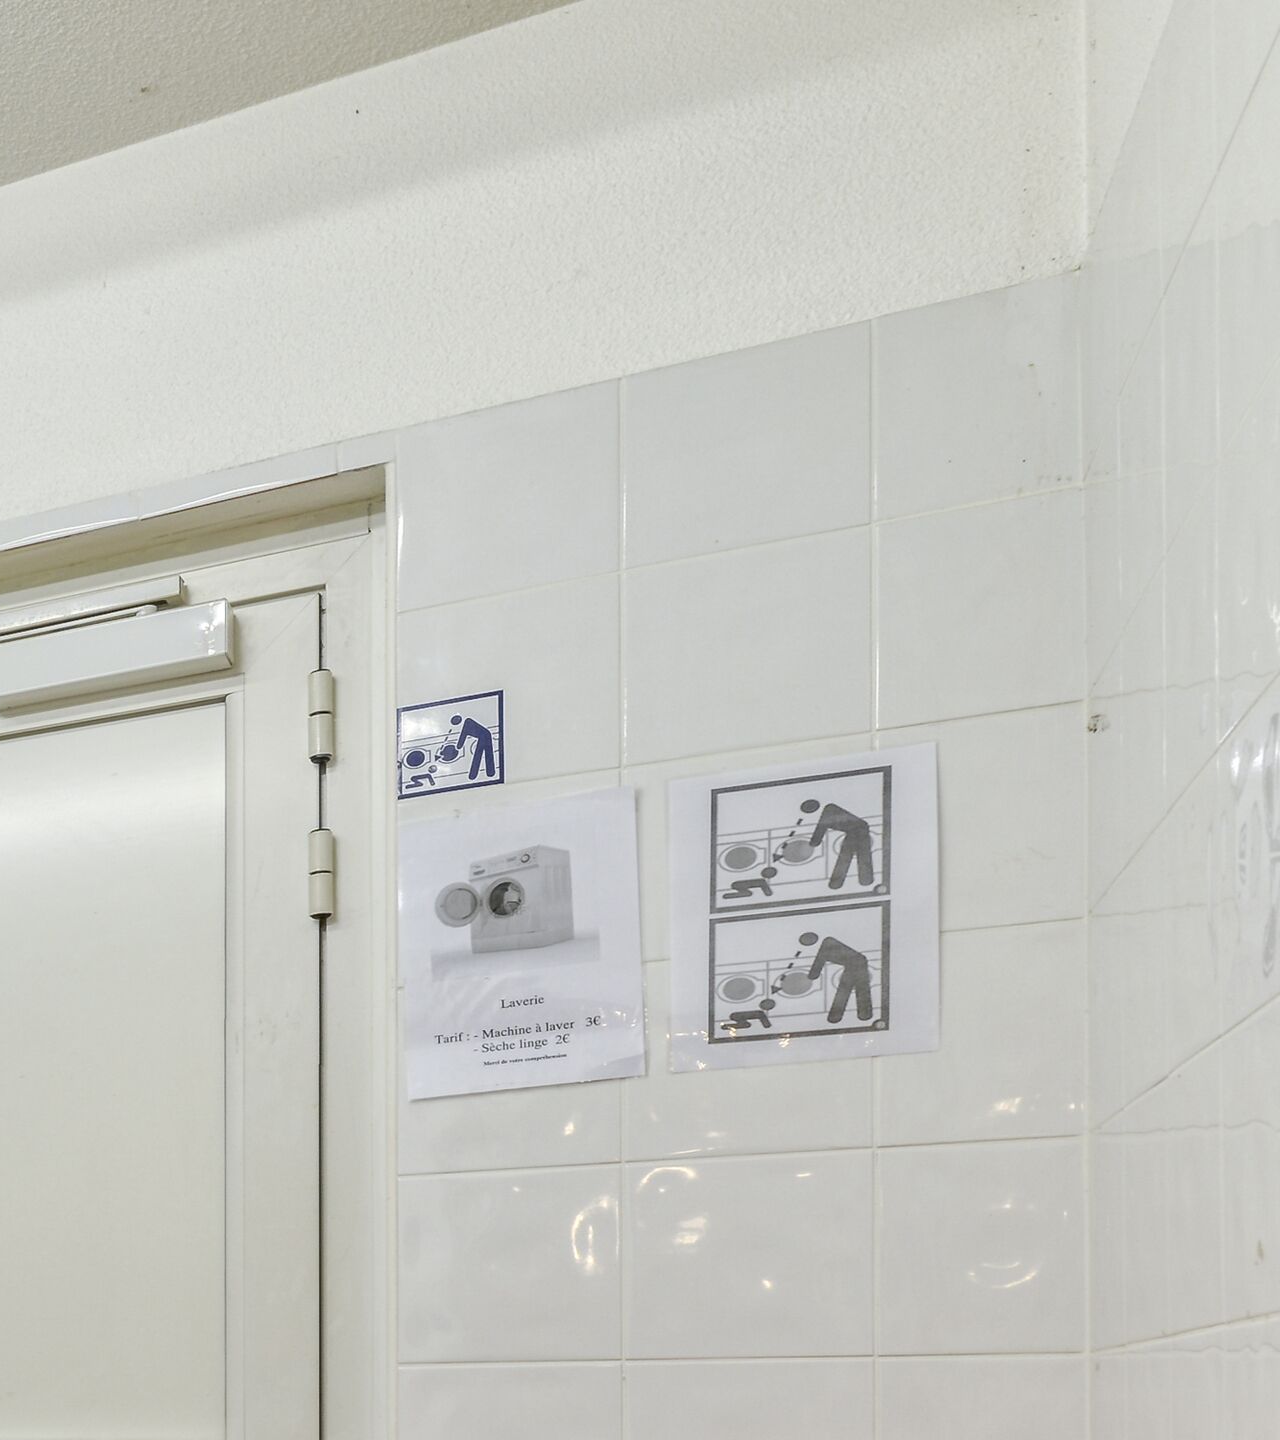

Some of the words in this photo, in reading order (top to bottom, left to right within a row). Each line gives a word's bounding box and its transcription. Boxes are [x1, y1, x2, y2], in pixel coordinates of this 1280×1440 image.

[500, 995, 544, 1008] Laverie
[433, 1031, 465, 1045] Tarif
[482, 1025, 532, 1038] Machine
[535, 1023, 541, 1032] à
[545, 1021, 575, 1031] laver
[585, 1015, 601, 1027] 3€
[481, 1041, 515, 1053] Sèche
[519, 1038, 548, 1050] linge
[554, 1033, 570, 1044] 2€
